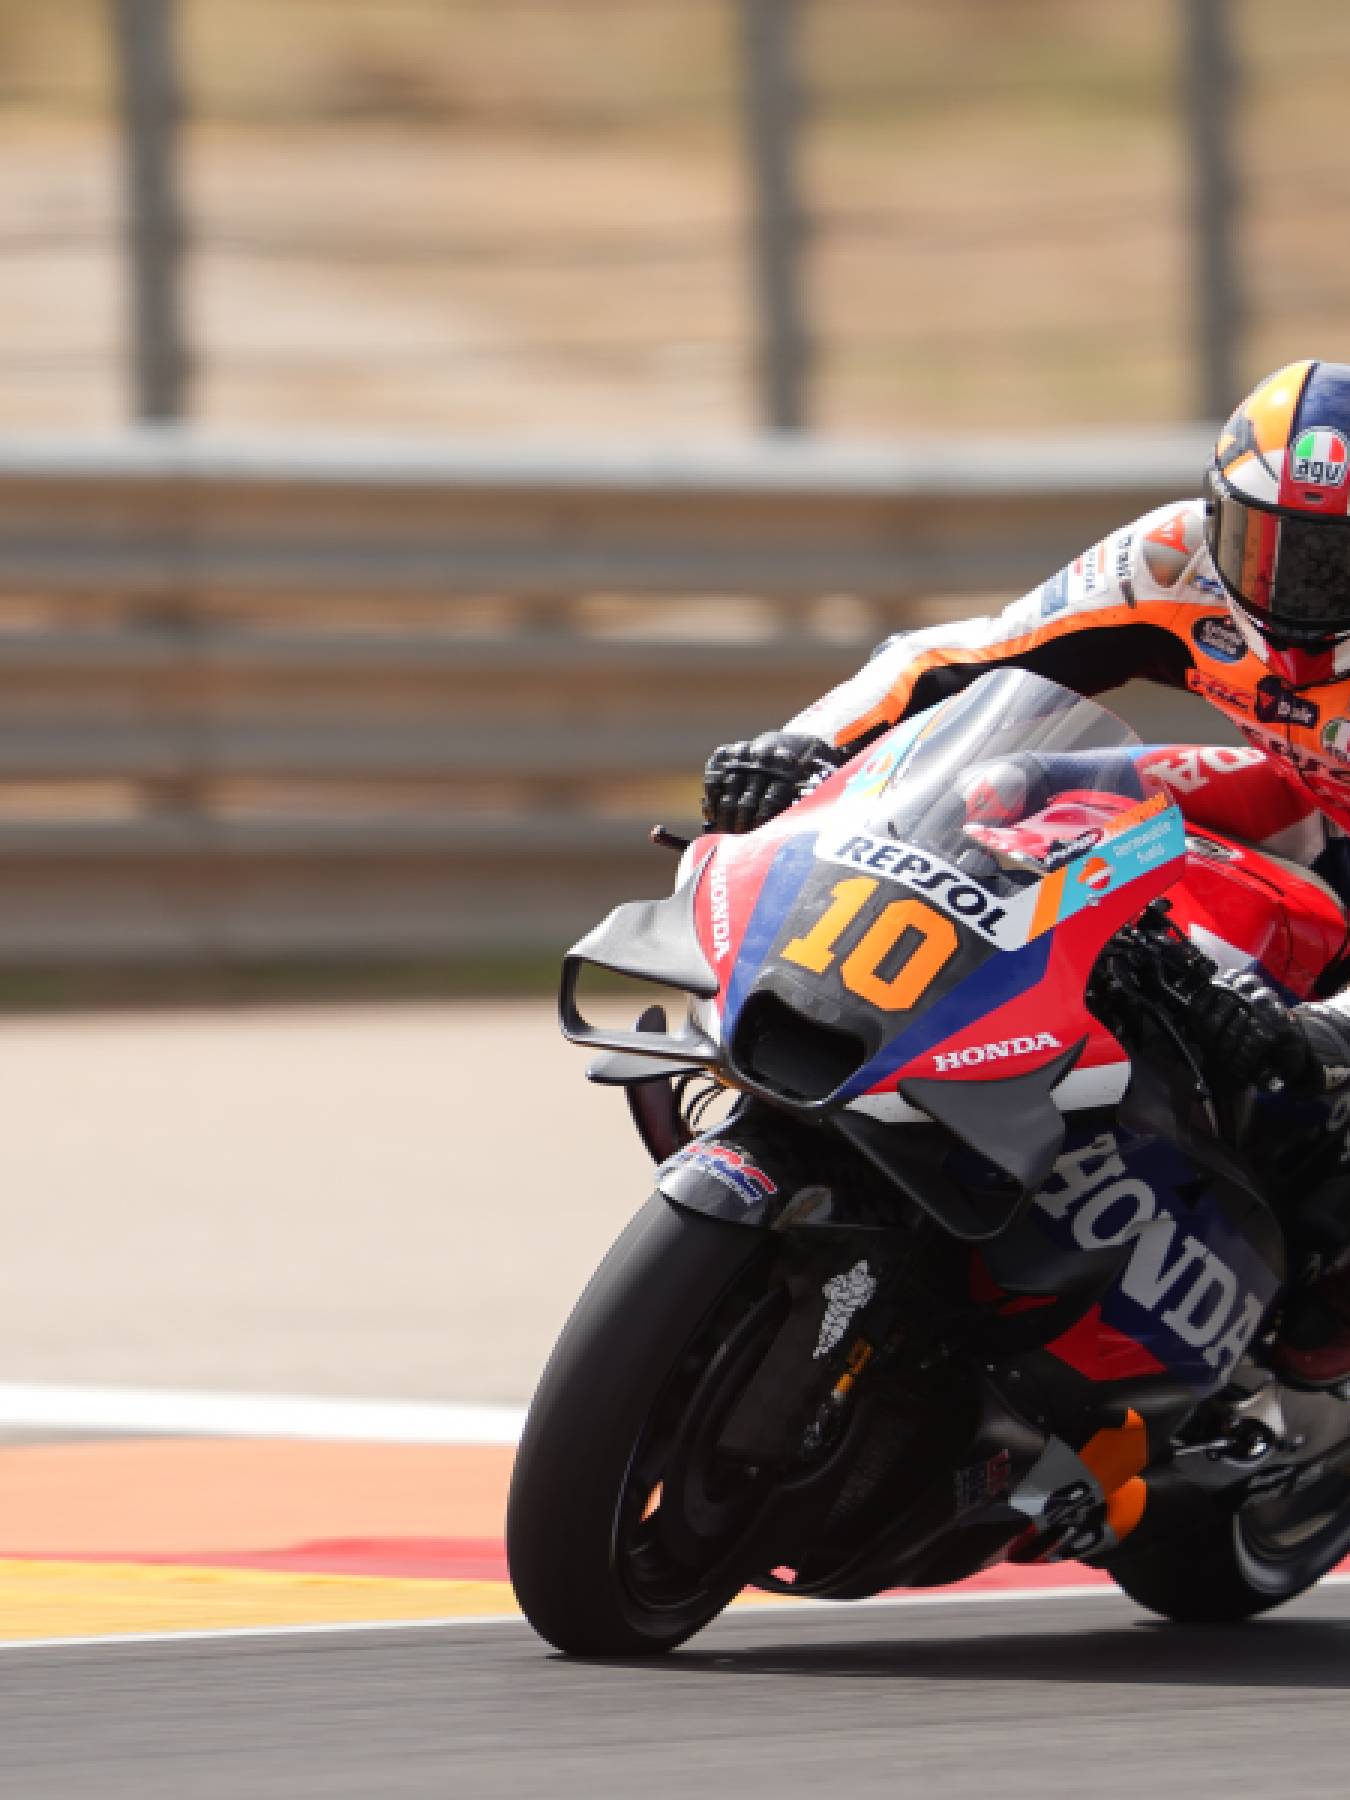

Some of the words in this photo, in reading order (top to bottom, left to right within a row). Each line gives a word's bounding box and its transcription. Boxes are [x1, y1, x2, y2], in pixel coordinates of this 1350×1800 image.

[1294, 458, 1346, 484] agv
[709, 868, 731, 961] HONDA
[836, 832, 1009, 938] REPSOL
[780, 876, 959, 1013] 10
[932, 1031, 1062, 1073] HONDA
[1033, 1131, 1264, 1389] HONDA
